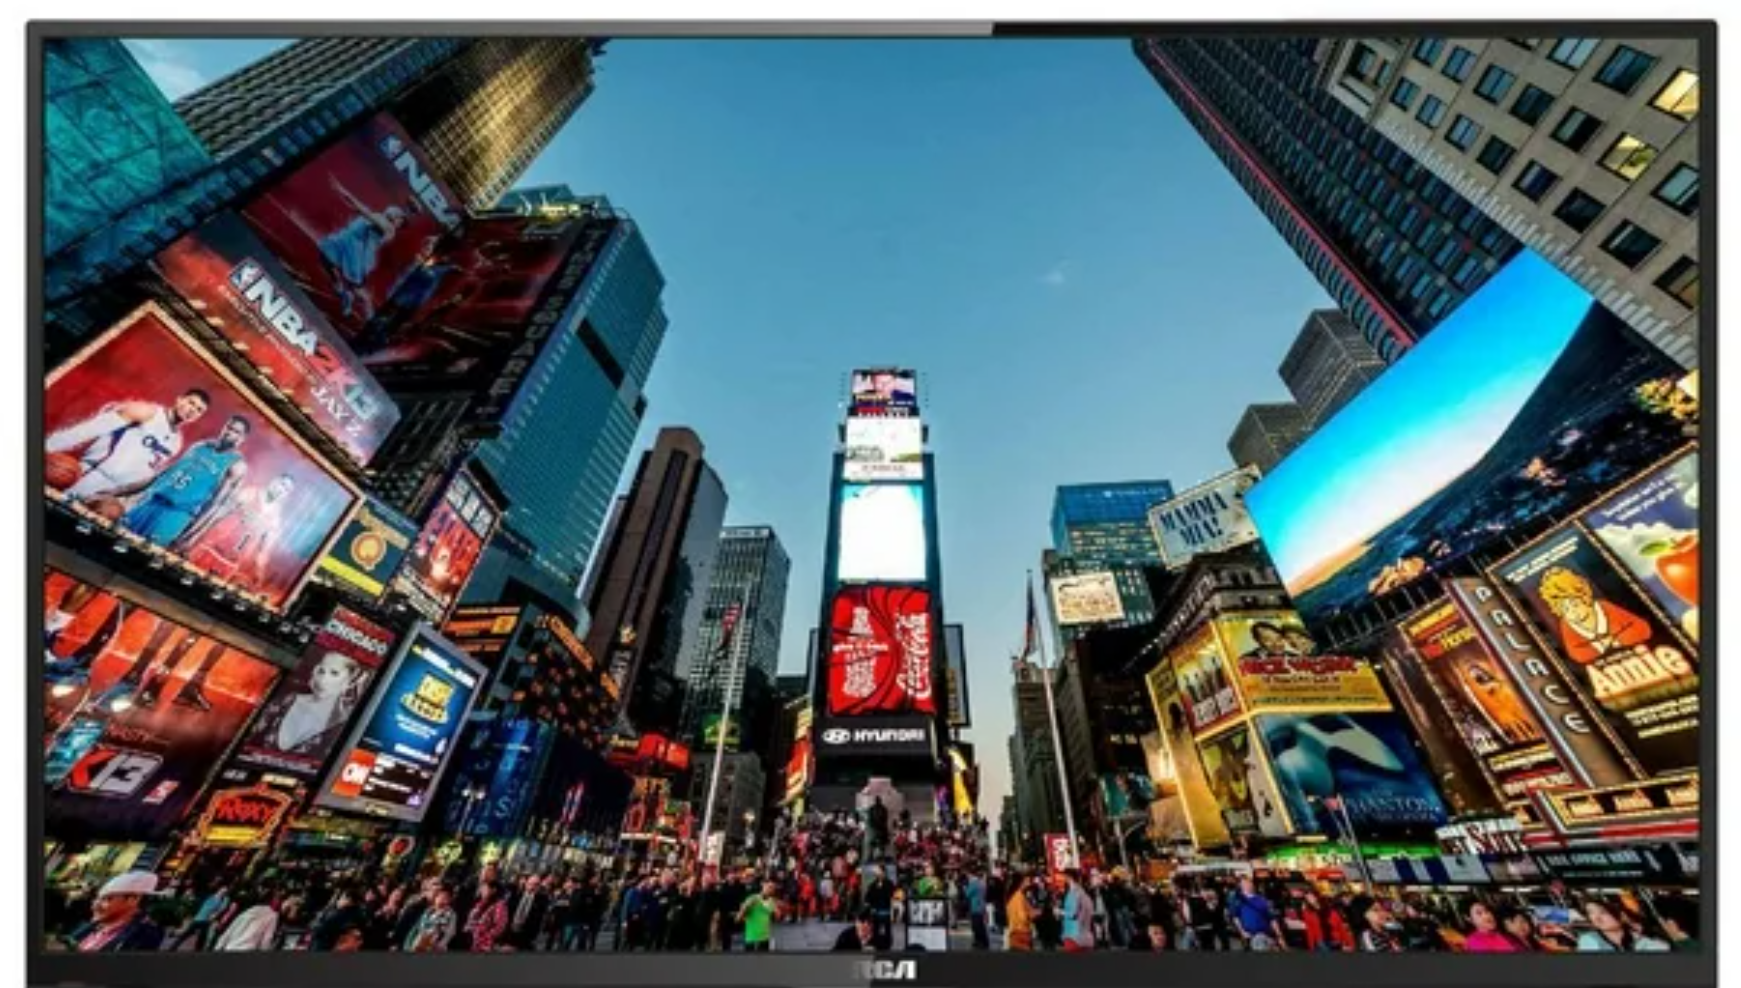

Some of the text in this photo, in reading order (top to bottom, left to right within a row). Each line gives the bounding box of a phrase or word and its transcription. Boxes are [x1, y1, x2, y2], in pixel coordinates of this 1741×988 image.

[1160, 491, 1228, 530] MAMMA
[327, 619, 388, 655] CHICAGO
[1586, 645, 1693, 698] Annie
[854, 728, 926, 742] HYUNDAI
